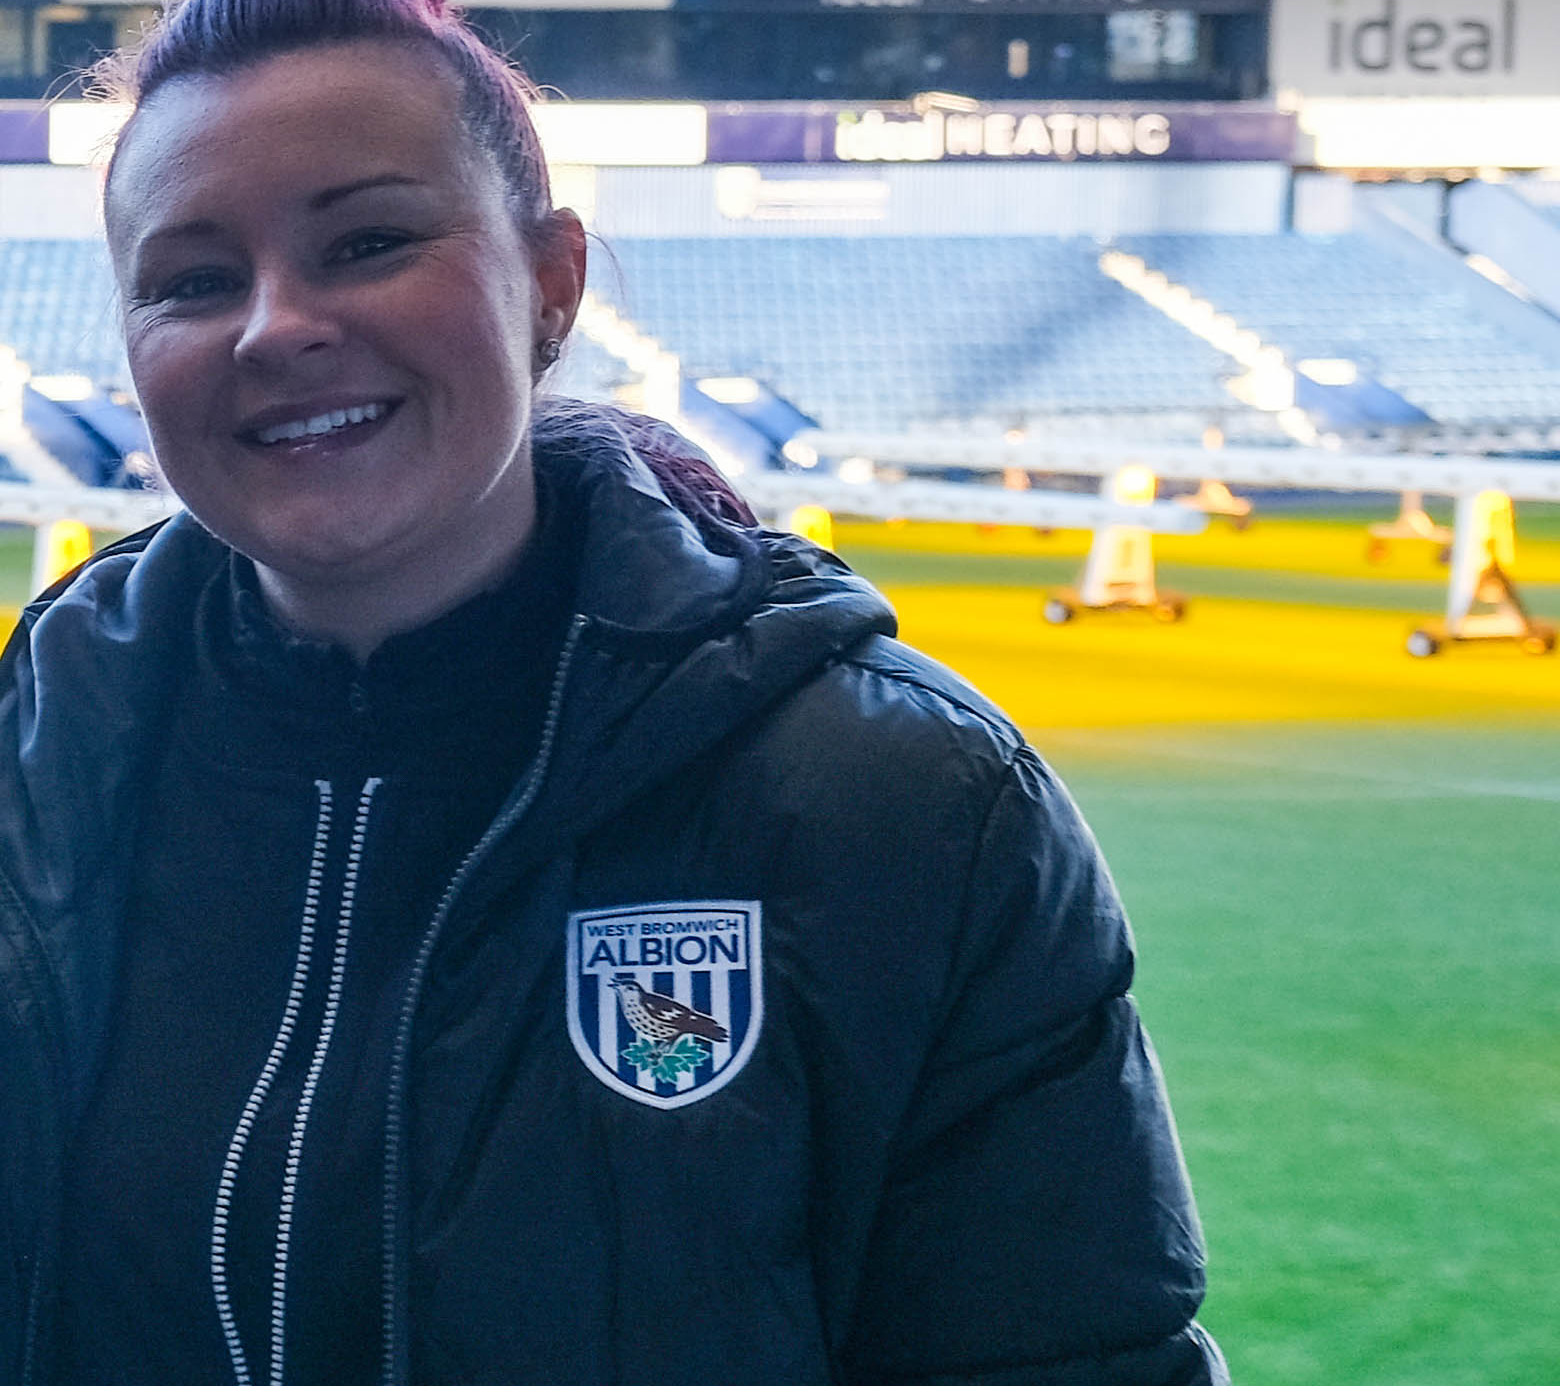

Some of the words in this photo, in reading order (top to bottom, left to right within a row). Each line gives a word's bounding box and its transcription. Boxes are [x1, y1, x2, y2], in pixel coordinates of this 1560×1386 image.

[946, 113, 1171, 156] HEATING
[587, 923, 637, 937] WEST
[640, 918, 739, 935] BROMWICH
[586, 933, 740, 968] ALBION
